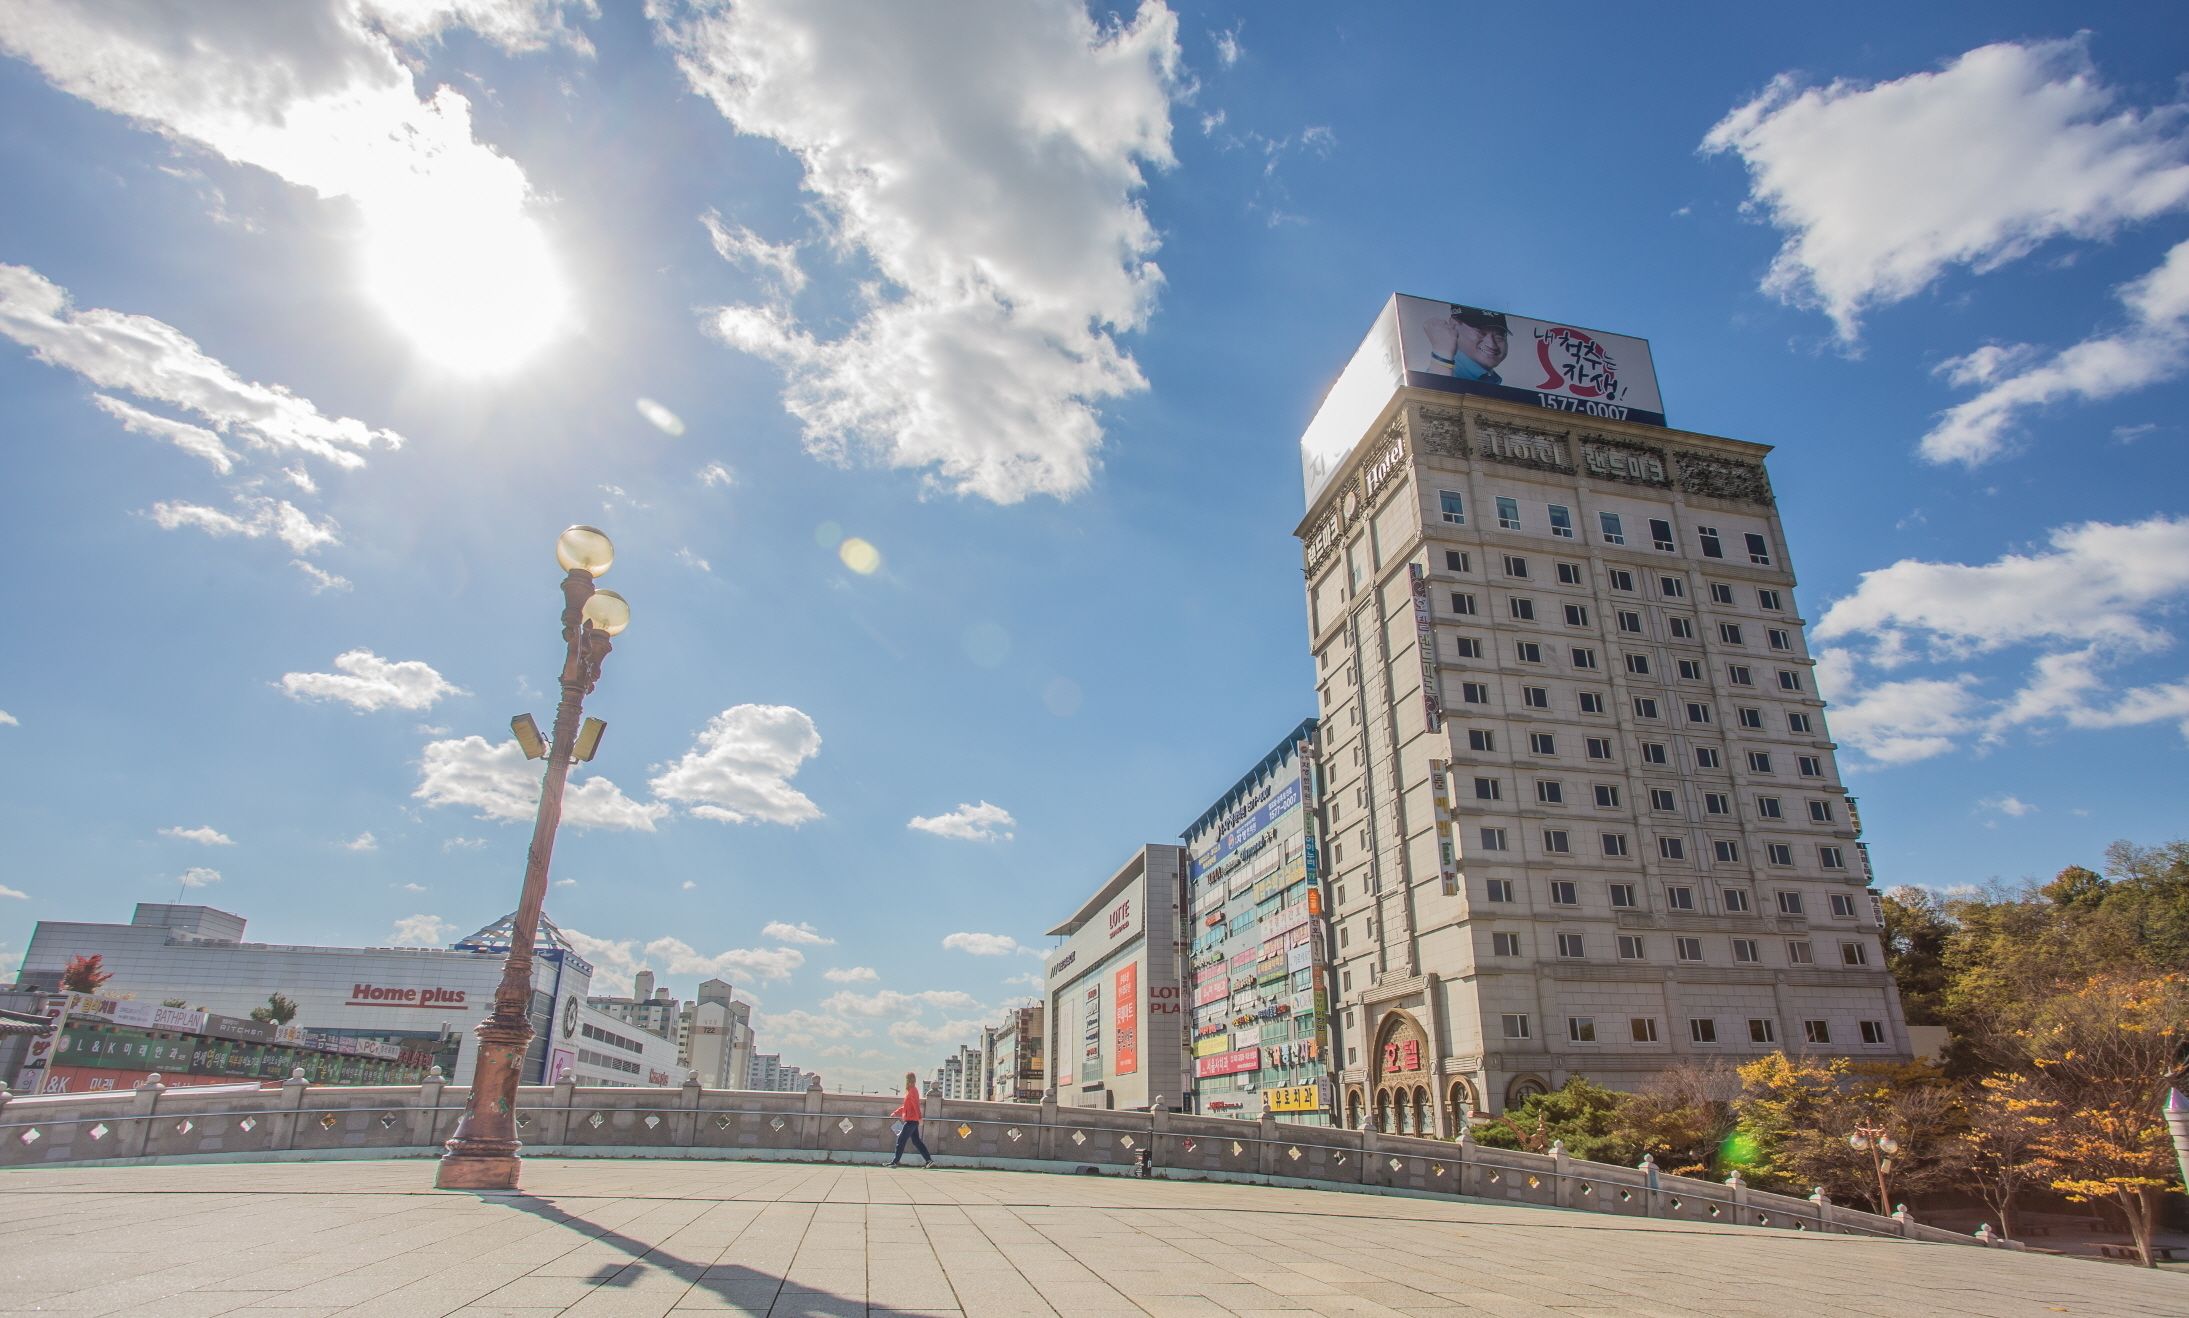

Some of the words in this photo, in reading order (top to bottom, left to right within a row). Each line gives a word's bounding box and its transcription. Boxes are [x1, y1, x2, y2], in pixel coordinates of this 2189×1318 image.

[1533, 327, 1555, 345] 내
[1559, 331, 1619, 371] 척추는
[1562, 363, 1628, 401] 자생!
[1538, 393, 1628, 421] 1577-0007
[1485, 432, 1562, 466] Hotel
[1585, 446, 1666, 482] 랜드마크
[1365, 437, 1405, 496] Hotel
[1109, 900, 1130, 930] LOTTE
[352, 984, 417, 1001] Home
[419, 987, 466, 1006] plus
[154, 1008, 200, 1028] BATHPLAN
[1384, 1039, 1420, 1073] 호텔
